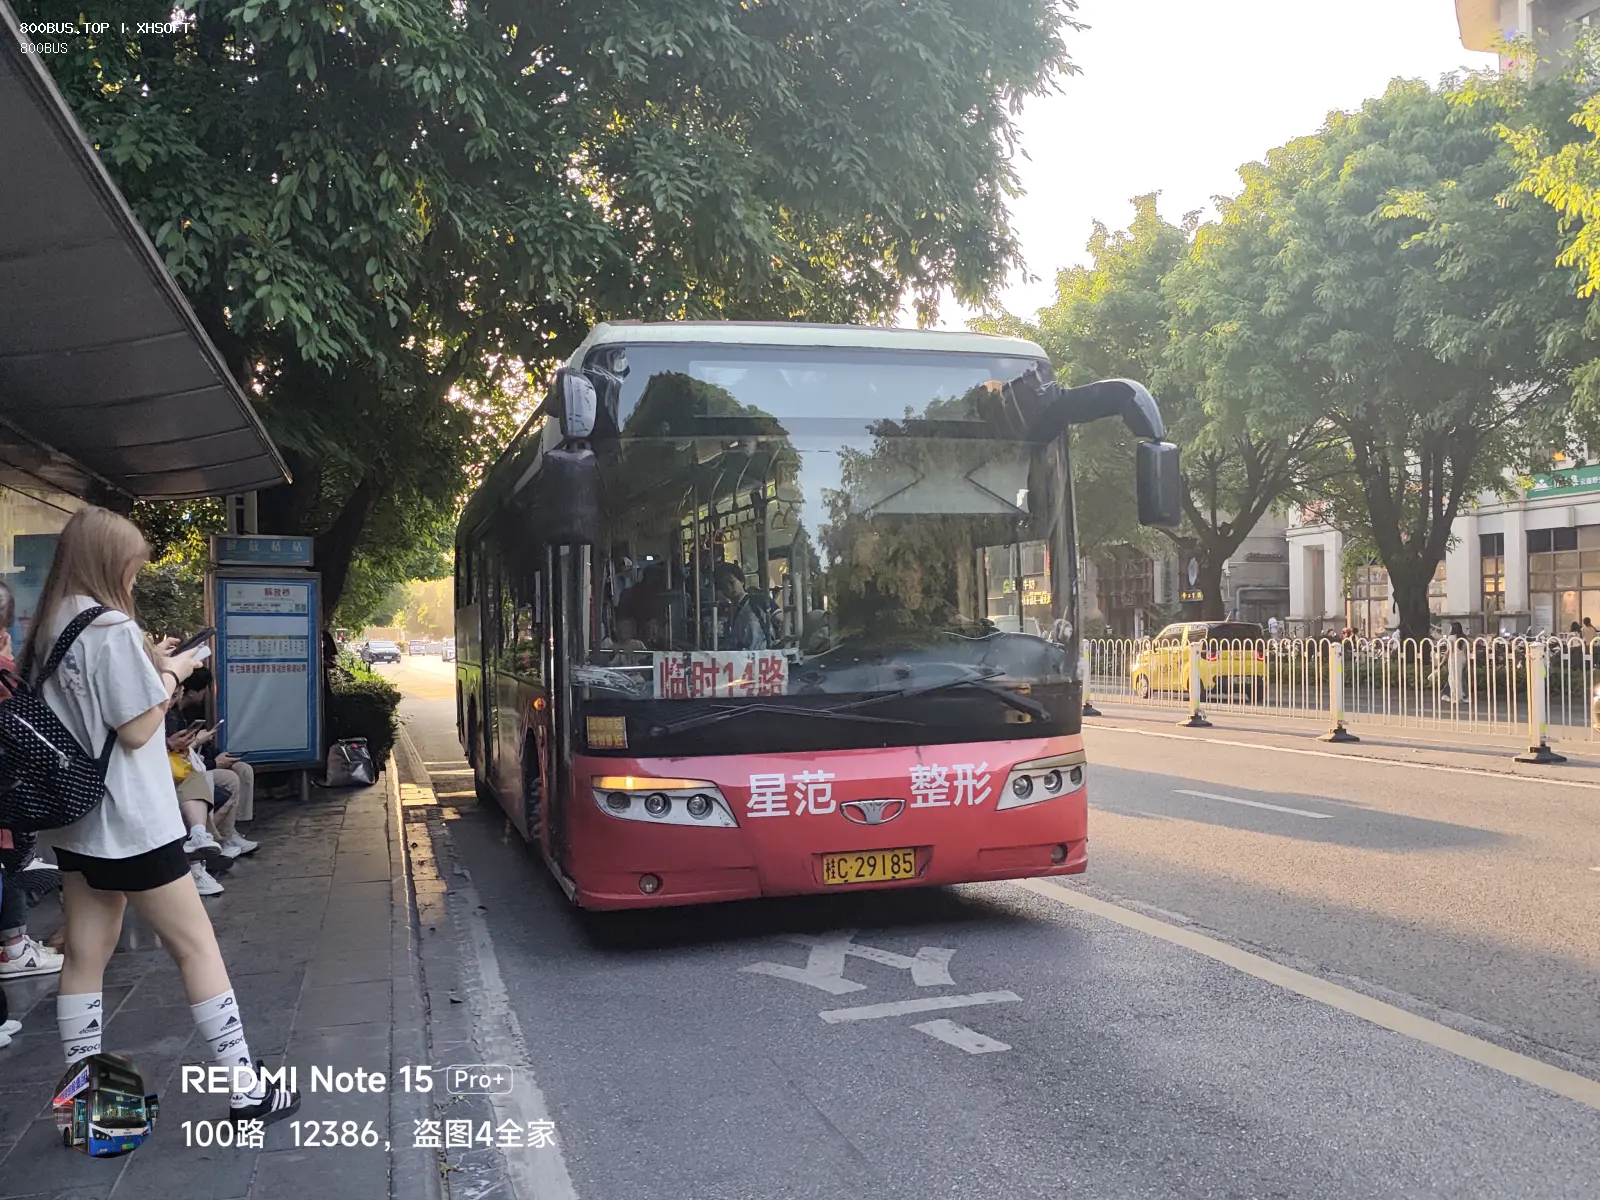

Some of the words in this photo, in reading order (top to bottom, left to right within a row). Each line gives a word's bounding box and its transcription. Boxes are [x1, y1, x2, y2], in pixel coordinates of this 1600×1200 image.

[659, 655, 785, 699] 临时14路
[746, 769, 837, 818] 星范
[908, 761, 993, 809] 整形
